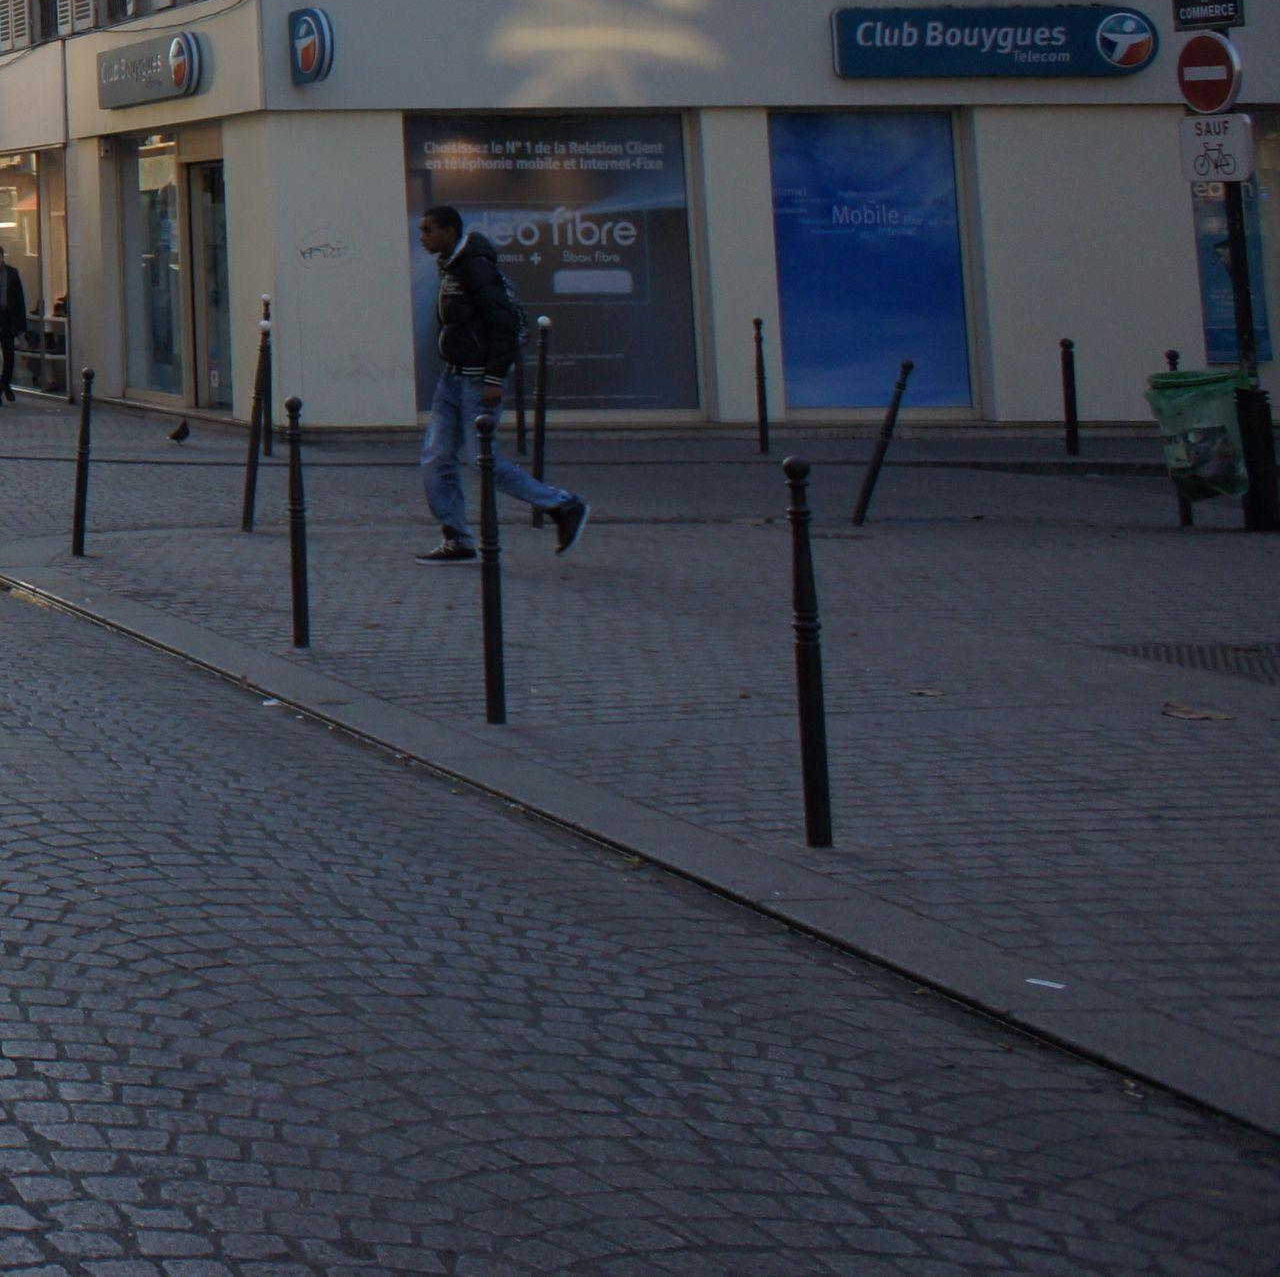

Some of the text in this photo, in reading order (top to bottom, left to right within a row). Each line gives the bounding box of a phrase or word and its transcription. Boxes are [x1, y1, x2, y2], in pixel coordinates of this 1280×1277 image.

[1179, 3, 1236, 20] COMMERCE
[855, 22, 1068, 54] Club Bouygues
[1014, 50, 1071, 64] Telecom
[1194, 122, 1230, 137] SAUF
[423, 141, 488, 154] Choisissez
[491, 140, 503, 154] le
[535, 141, 551, 154] de
[554, 141, 566, 154] la
[568, 141, 623, 154] Relation
[625, 141, 664, 154] Client
[425, 159, 440, 170] en
[516, 157, 560, 170] mobile
[562, 159, 577, 170] et
[833, 204, 899, 225] Mobile
[549, 206, 638, 246] fibre
[594, 250, 621, 263] fibre
